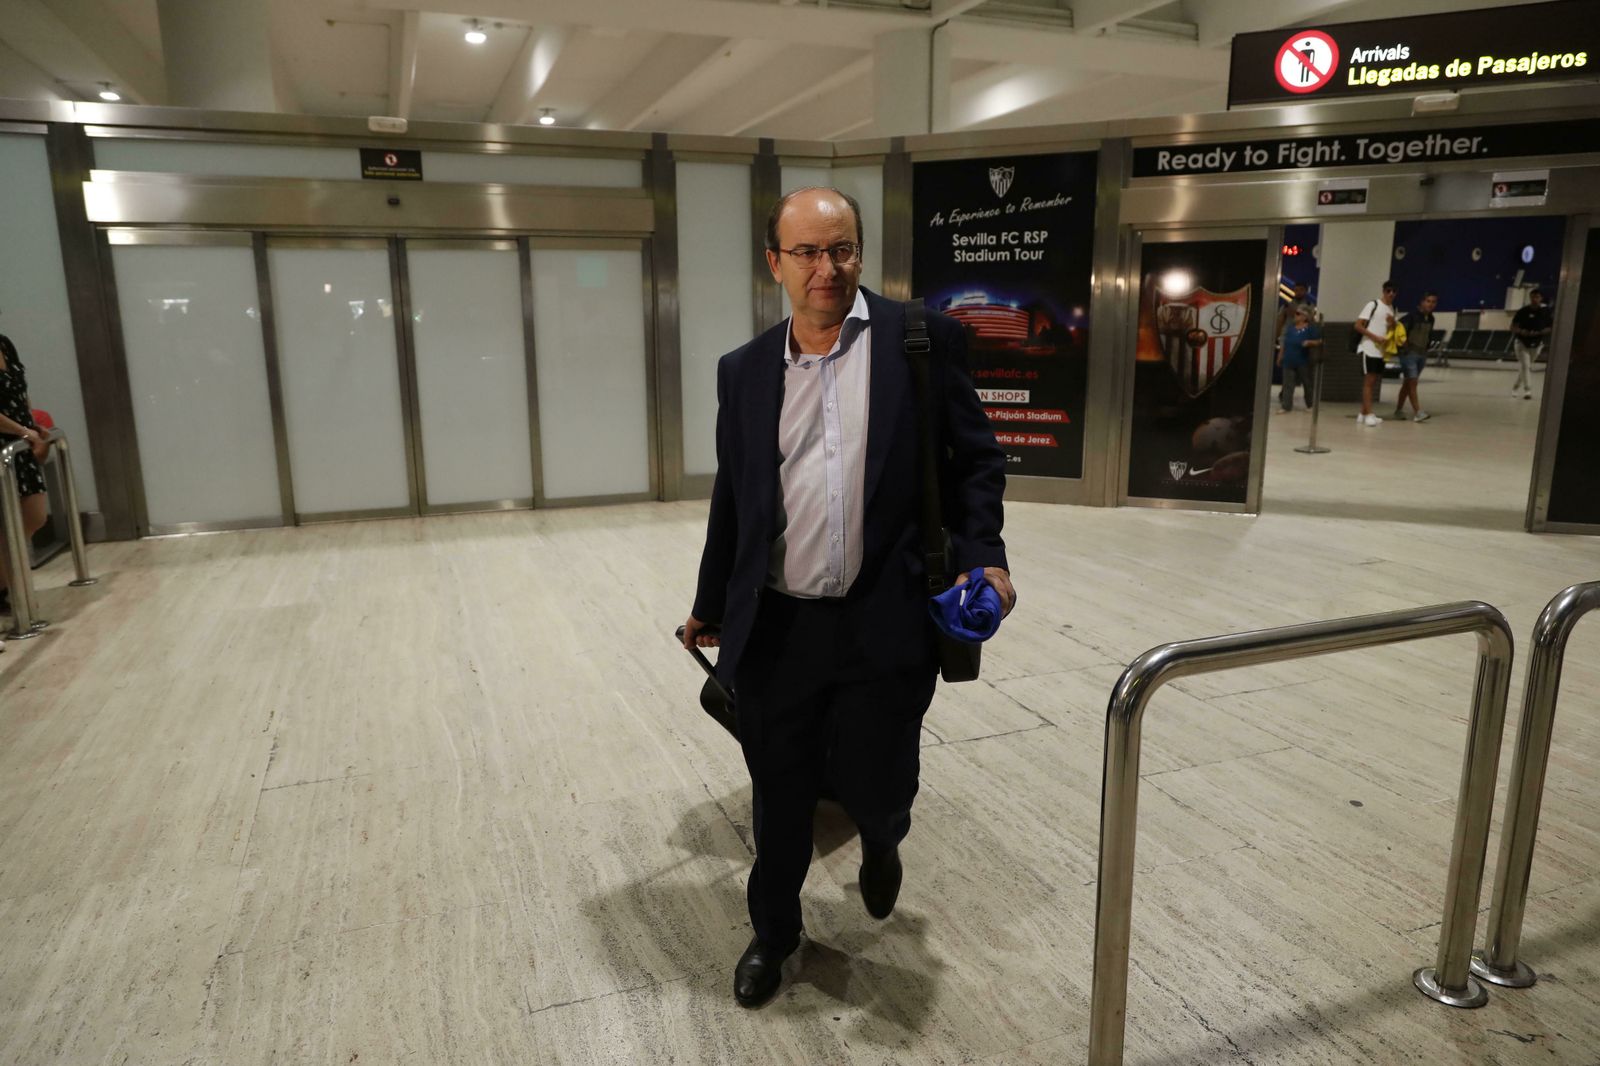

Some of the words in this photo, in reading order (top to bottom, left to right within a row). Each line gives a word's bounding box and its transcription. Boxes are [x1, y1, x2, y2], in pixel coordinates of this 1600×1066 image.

[1350, 43, 1410, 64] Arrivals
[1347, 62, 1440, 87] Llegadas
[1445, 58, 1472, 78] de
[1477, 51, 1588, 76] Pasajeros
[1157, 147, 1237, 172] Ready
[1244, 146, 1269, 166] to
[1277, 140, 1346, 167] Fight.
[1356, 134, 1488, 163] Together.
[930, 212, 944, 227] An
[949, 208, 1000, 226] Experience
[1006, 203, 1016, 214] to
[1020, 193, 1072, 212] Remember
[952, 232, 997, 247] Sevilla
[1001, 231, 1019, 245] FC
[1024, 230, 1049, 244] RSP
[954, 249, 1010, 263] Stadium
[1014, 248, 1045, 261] Tour
[992, 391, 1026, 401] SHOPS
[1026, 412, 1062, 421] Stadium
[995, 435, 1012, 443] erta
[1014, 434, 1025, 443] de
[1027, 435, 1051, 445] Jerez
